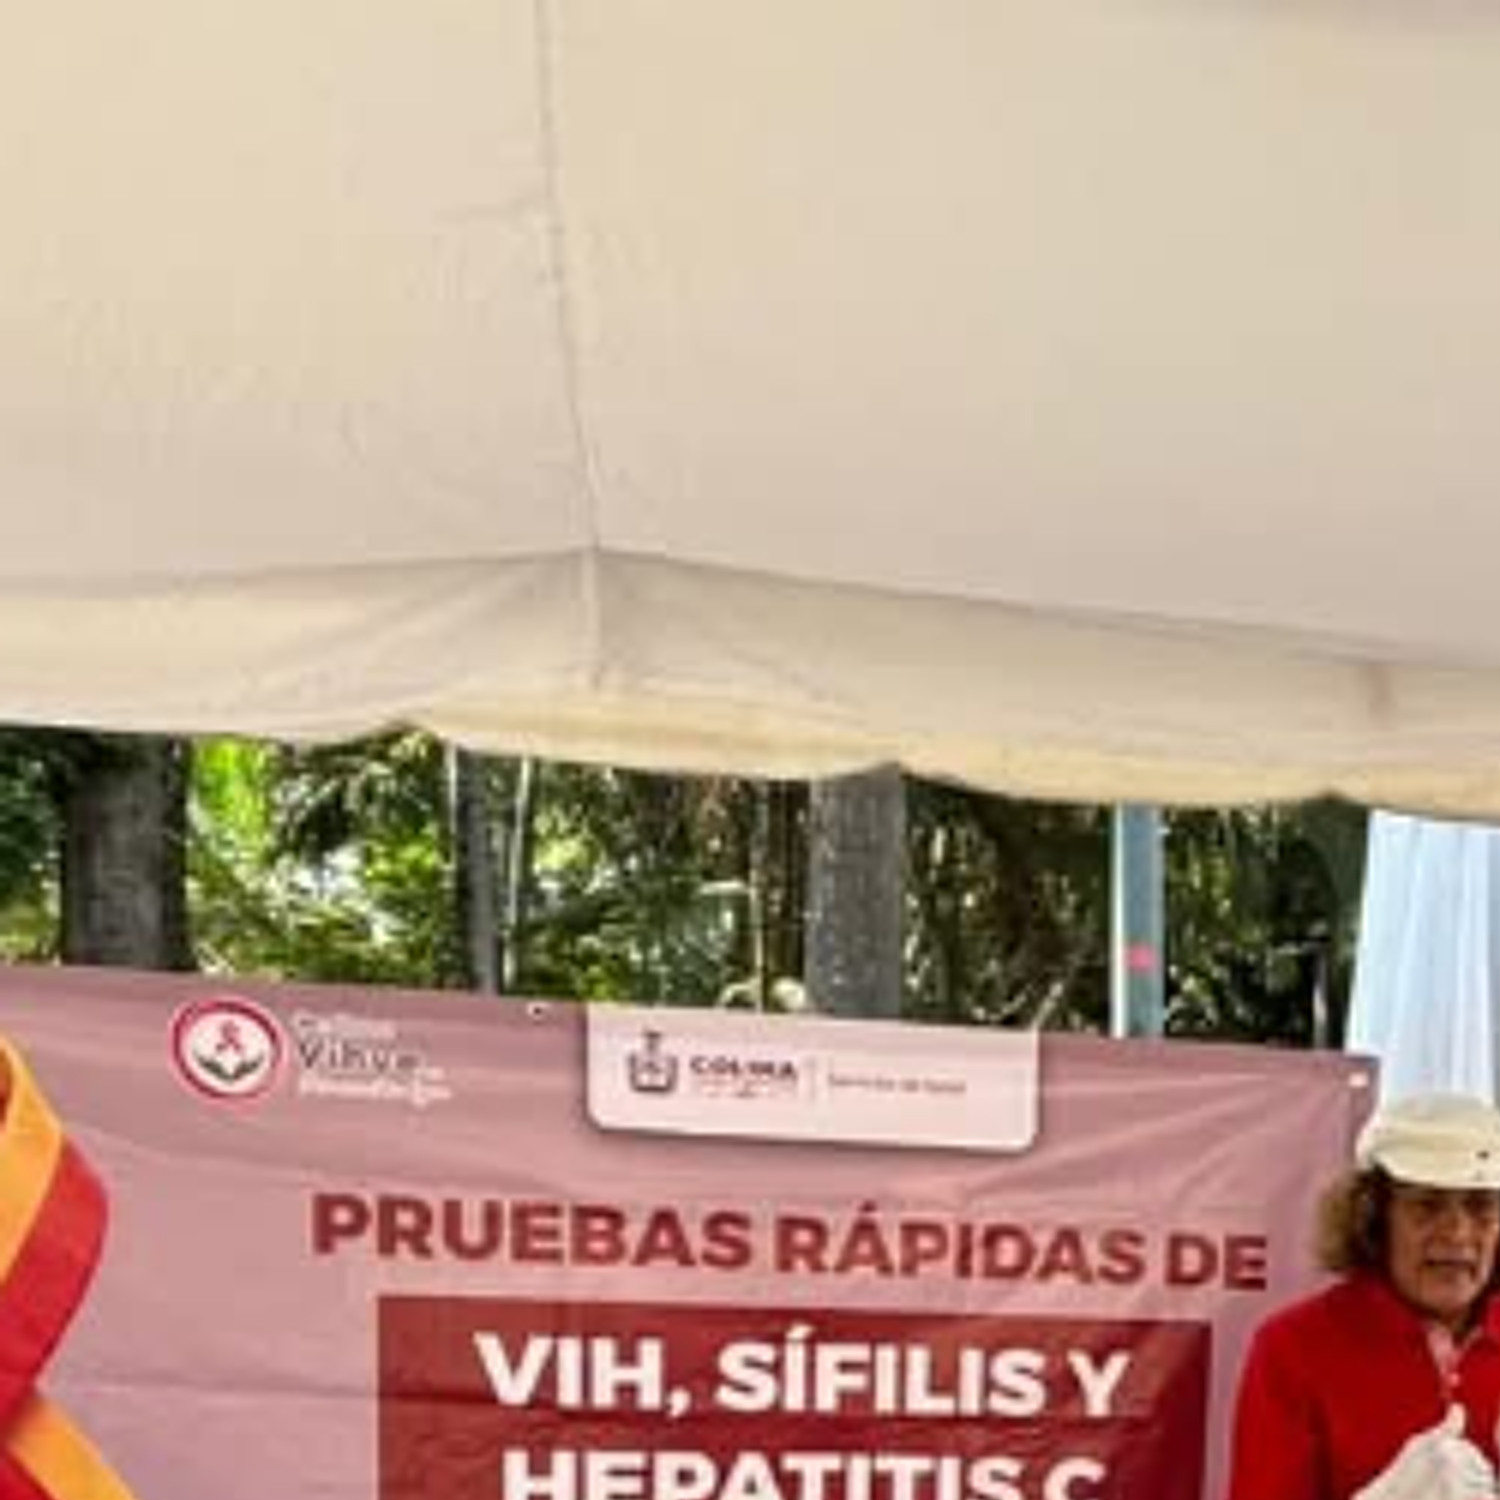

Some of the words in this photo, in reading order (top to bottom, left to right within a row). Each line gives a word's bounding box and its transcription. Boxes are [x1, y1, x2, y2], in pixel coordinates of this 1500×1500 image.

[312, 1192, 754, 1271] PRUEBAS
[774, 1201, 1147, 1286] RÁPIDAS
[1163, 1232, 1268, 1291] DE
[474, 1331, 692, 1417] VIH,
[715, 1325, 1047, 1418] SÍFILIS
[1068, 1351, 1131, 1418] Y
